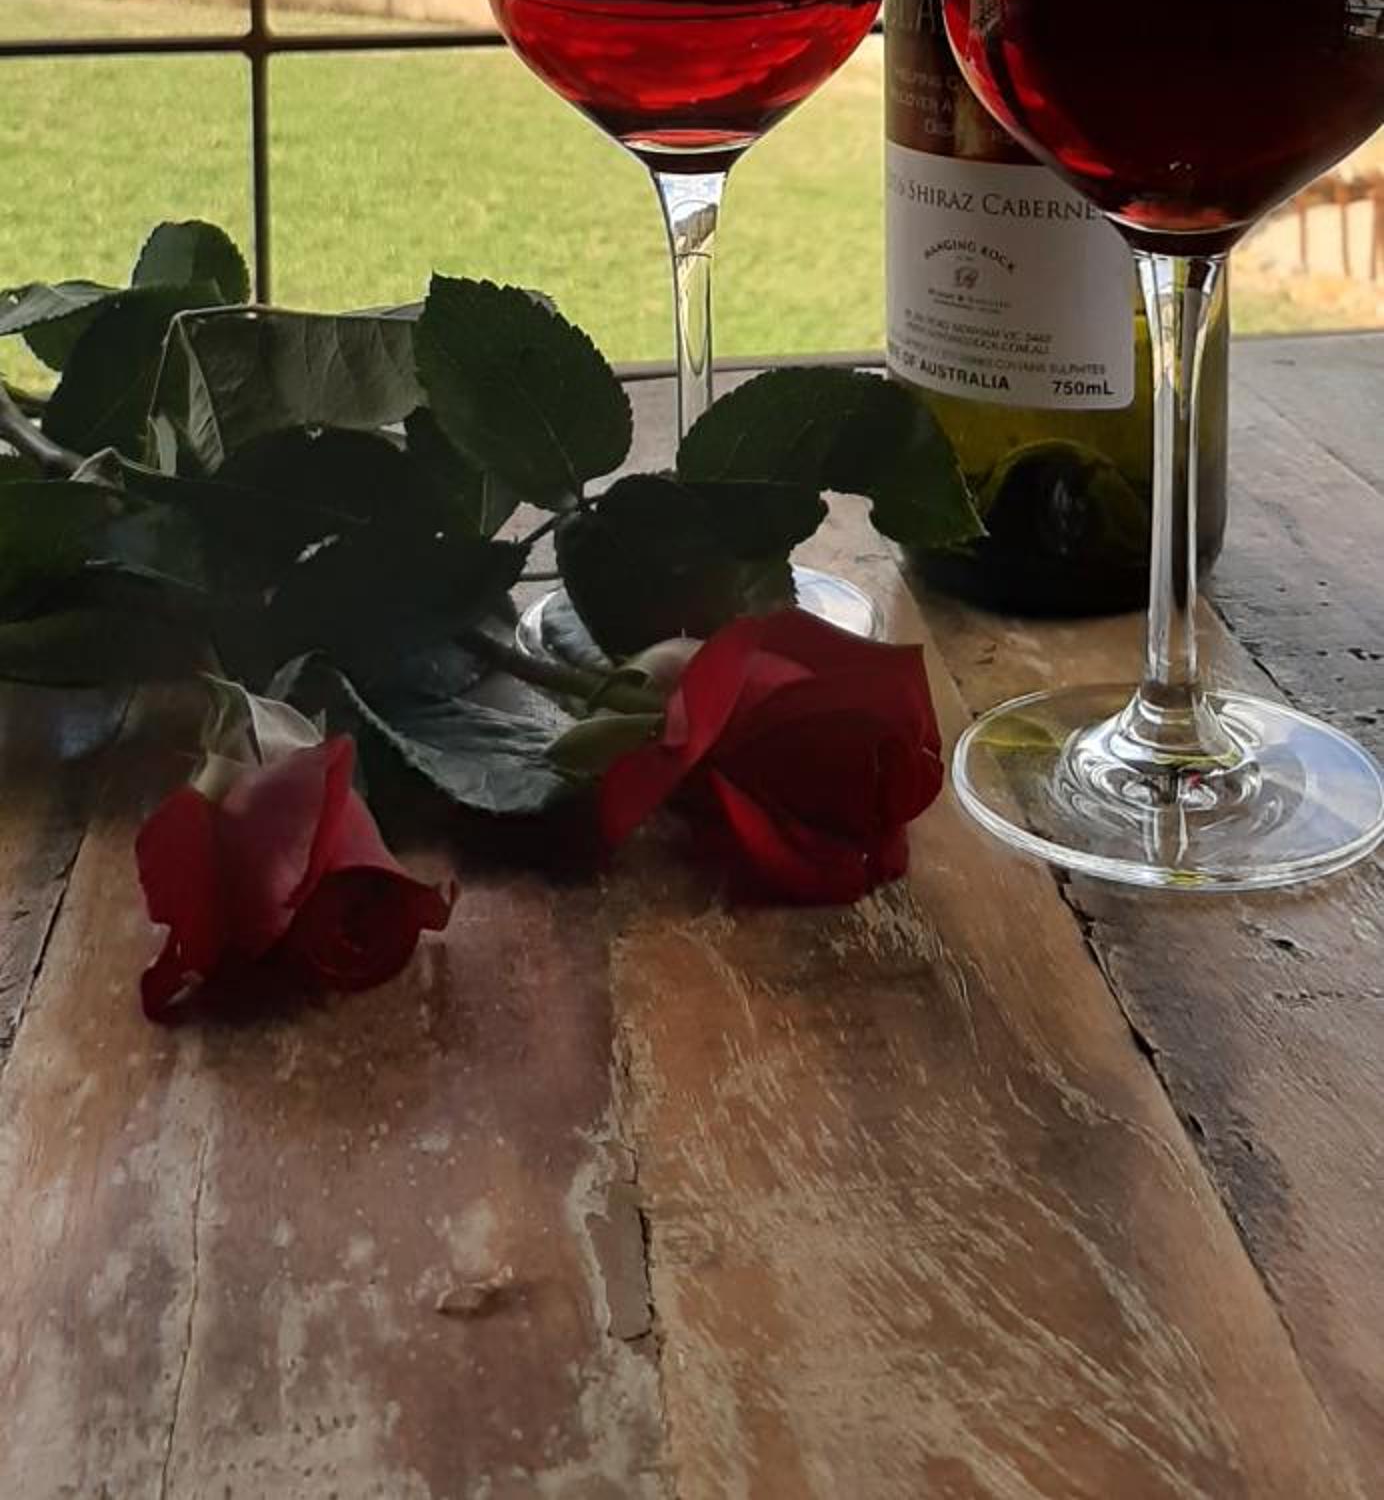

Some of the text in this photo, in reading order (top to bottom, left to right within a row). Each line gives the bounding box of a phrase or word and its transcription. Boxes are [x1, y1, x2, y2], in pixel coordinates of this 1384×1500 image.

[908, 180, 975, 212] SHIRAZ
[981, 192, 1098, 221] CABERNE
[919, 358, 1011, 391] AUSTRALIA
[1050, 379, 1116, 397] 750mL
